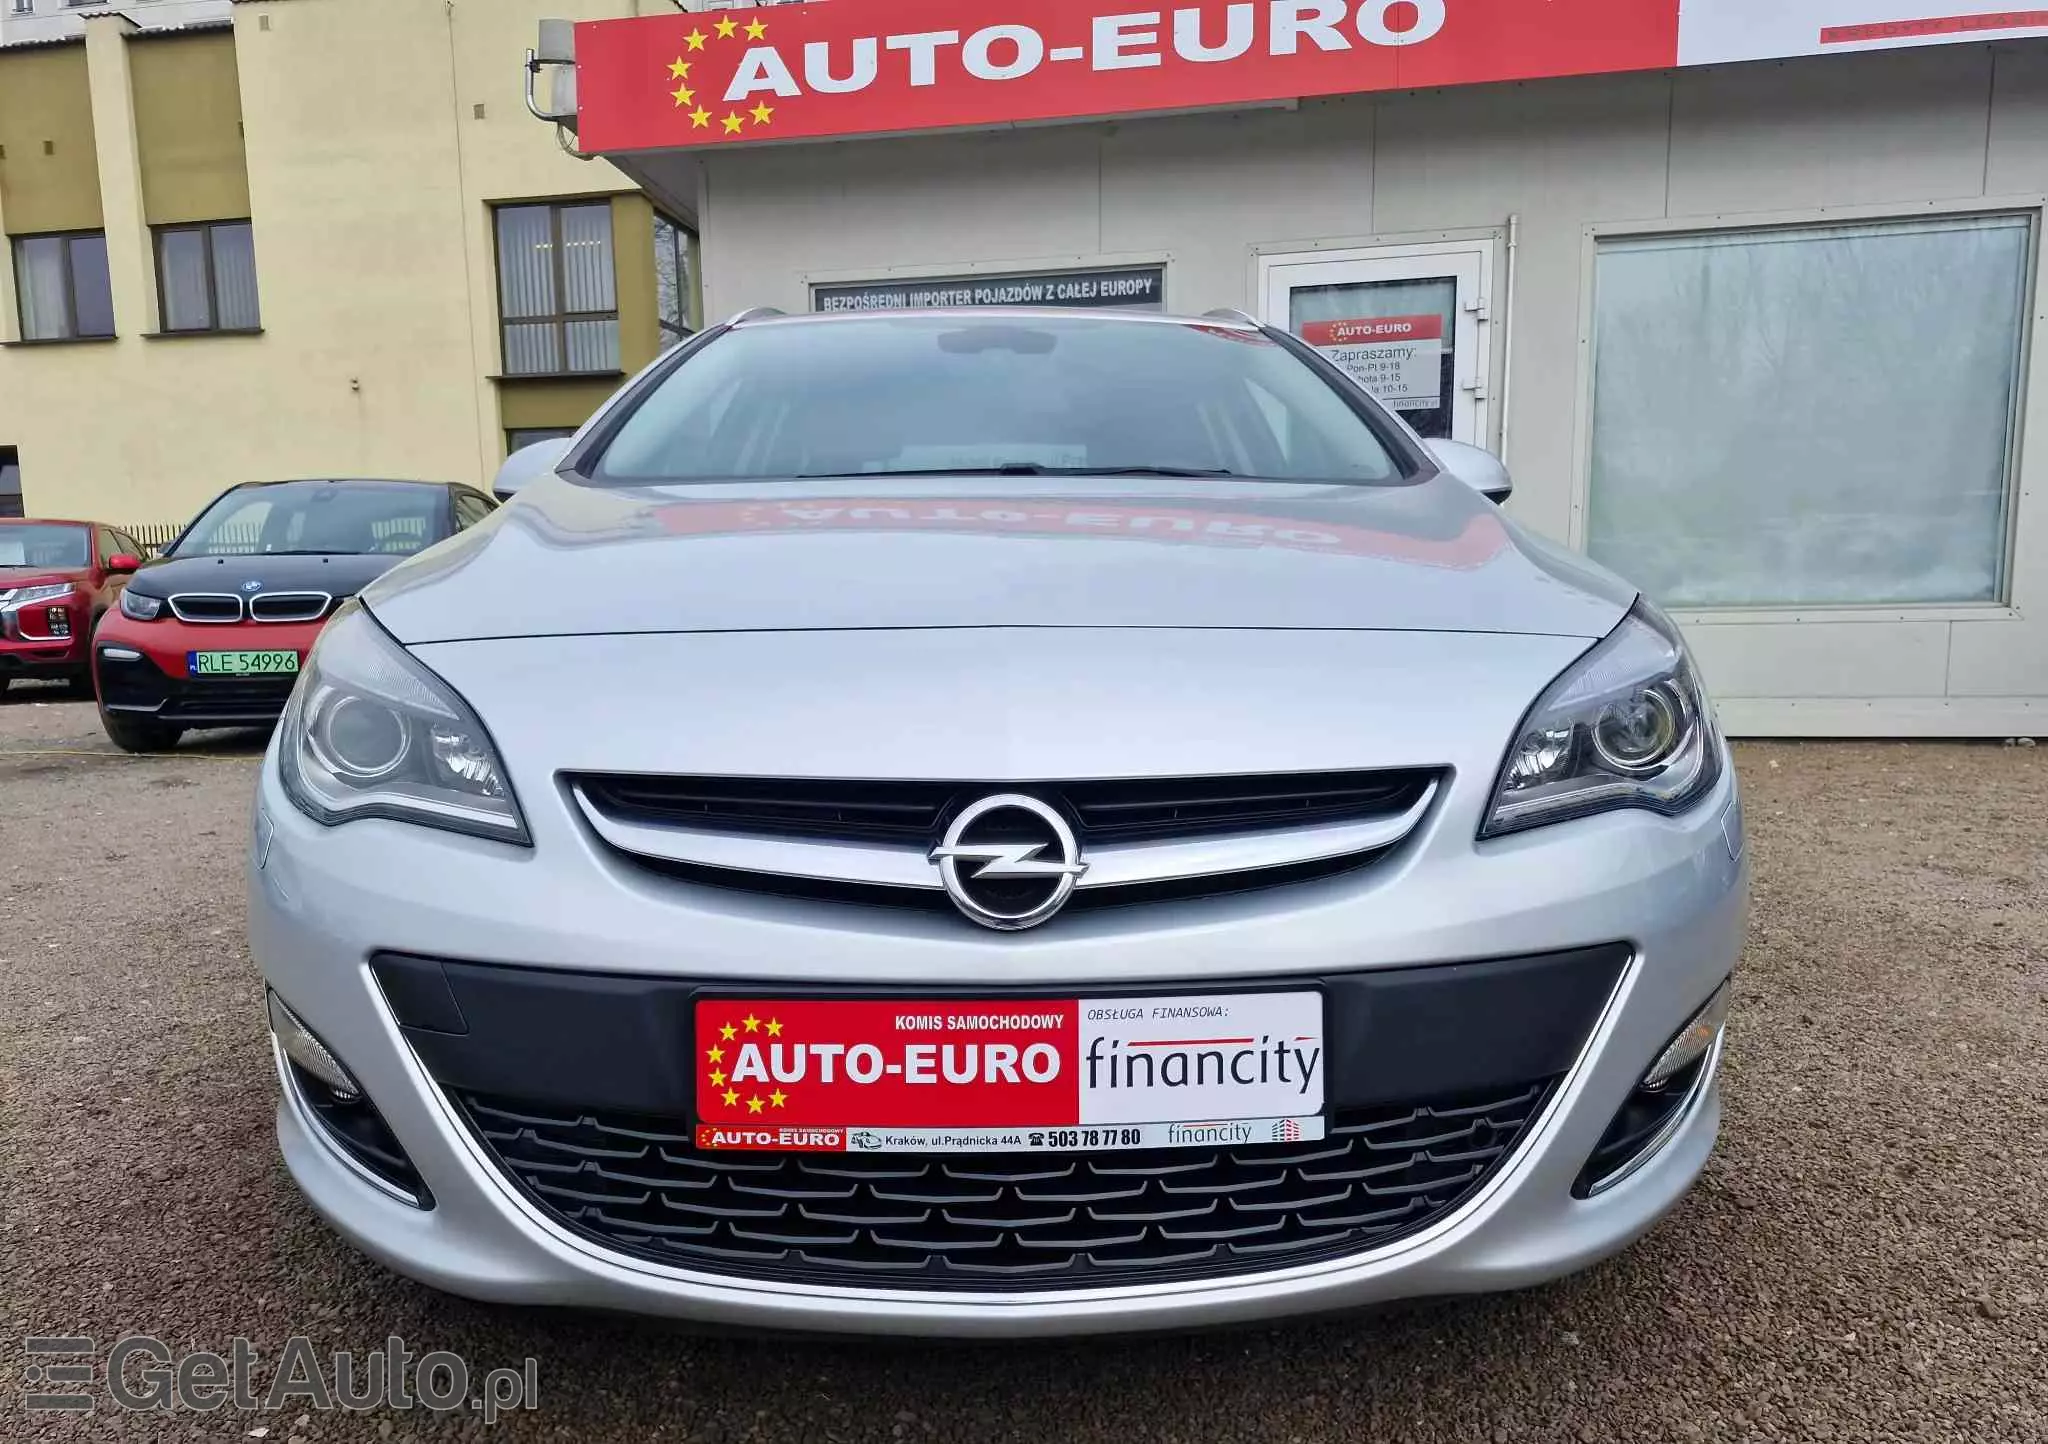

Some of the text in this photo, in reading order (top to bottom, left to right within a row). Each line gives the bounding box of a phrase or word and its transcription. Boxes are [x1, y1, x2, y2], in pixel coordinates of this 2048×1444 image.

[722, 0, 1447, 101] AUTO-EURO
[823, 278, 1153, 311] BEZPOŚREDNI IMPORTER POJAZDÓW Z CAŁEJ EUROPY
[1337, 323, 1412, 337] AUTO-EURO
[1331, 347, 1417, 363] Zapraszamy:
[198, 653, 296, 672] RLE 54996
[895, 1014, 1064, 1031] KOMIS SAMOCHODOWY
[1087, 1006, 1230, 1020] OBSŁUGA FINANSOWA:
[731, 1042, 1061, 1084] AUTO-EURO
[1086, 1035, 1320, 1094] financity
[711, 1131, 840, 1147] AUTO-EURO
[885, 1135, 928, 1147] Kraków,
[1001, 1135, 1022, 1146] 44A
[1048, 1128, 1141, 1147] 503 78 77 80
[1168, 1122, 1252, 1145] financity
